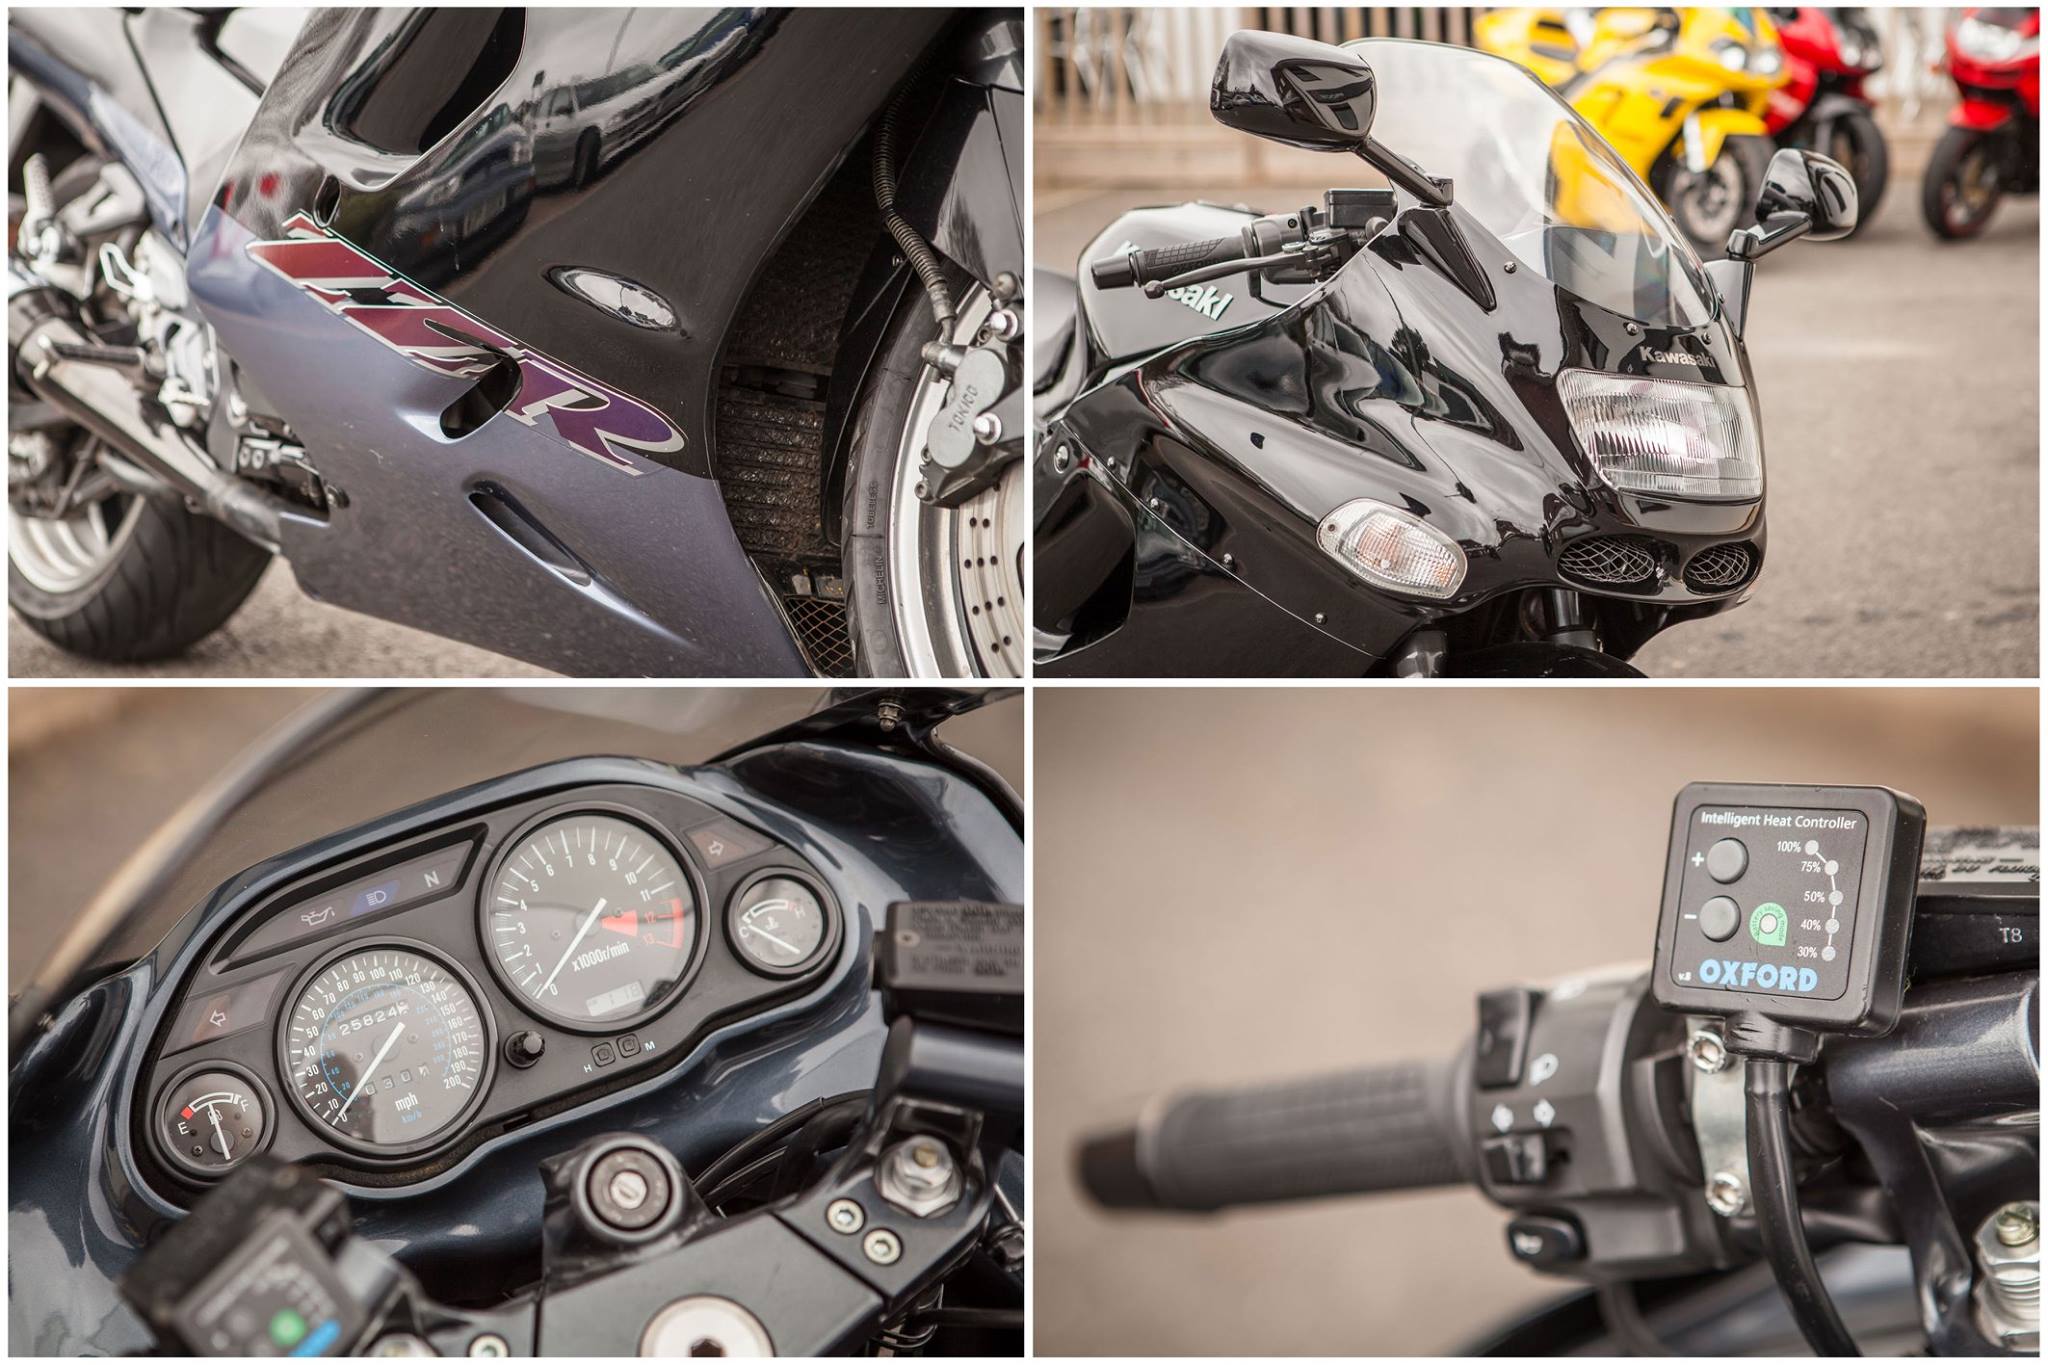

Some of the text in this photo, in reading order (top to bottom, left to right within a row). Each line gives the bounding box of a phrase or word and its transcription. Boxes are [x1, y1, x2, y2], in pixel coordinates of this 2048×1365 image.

[1640, 346, 1716, 368] Kawasaki
[948, 385, 978, 431] TOKICO
[875, 555, 888, 605] MICHELIN
[1701, 811, 1857, 830] Intelligent Heat Controller
[1777, 840, 1801, 853] 100%
[565, 855, 574, 868] 7
[587, 853, 596, 866] 8
[609, 858, 618, 871] 9
[545, 864, 555, 877] 6
[1801, 861, 1821, 873] 75%
[423, 870, 440, 888] N
[625, 872, 639, 886] 10
[530, 880, 540, 893] 5
[640, 889, 652, 902] 11
[1803, 891, 1825, 903] 50%
[519, 899, 528, 911] 4
[517, 922, 527, 935] 3
[1800, 919, 1821, 931] 40%
[738, 926, 749, 938] C
[1999, 927, 2023, 943] T8
[643, 934, 656, 945] 13
[523, 944, 533, 957] 2
[572, 941, 630, 973] x1000r/min
[1797, 946, 1818, 958] 30%
[369, 966, 386, 980] 100
[388, 968, 403, 982] 110
[535, 963, 543, 974] 1
[1699, 958, 1818, 992] OXFORD
[353, 970, 366, 983] 90
[404, 972, 421, 987] 120
[336, 979, 350, 992] 80
[419, 980, 436, 994] 130
[549, 984, 559, 996] 0
[323, 992, 337, 1005] 70
[431, 990, 448, 1003] 140
[311, 1008, 325, 1021] 60
[440, 1004, 457, 1017] 150
[448, 1016, 464, 1030] 160
[306, 1026, 319, 1039] 50
[452, 1031, 468, 1045] 170
[303, 1044, 316, 1057] 40
[644, 1040, 656, 1051] M
[453, 1046, 469, 1059] 180
[306, 1064, 319, 1077] 30
[451, 1060, 467, 1073] 190
[583, 1064, 592, 1073] H
[316, 1082, 328, 1095] 20
[444, 1075, 462, 1090] 200
[240, 1099, 250, 1112] F
[328, 1098, 340, 1111] 10
[395, 1092, 418, 1111] mph
[340, 1111, 348, 1123] 0
[177, 1121, 189, 1135] E
